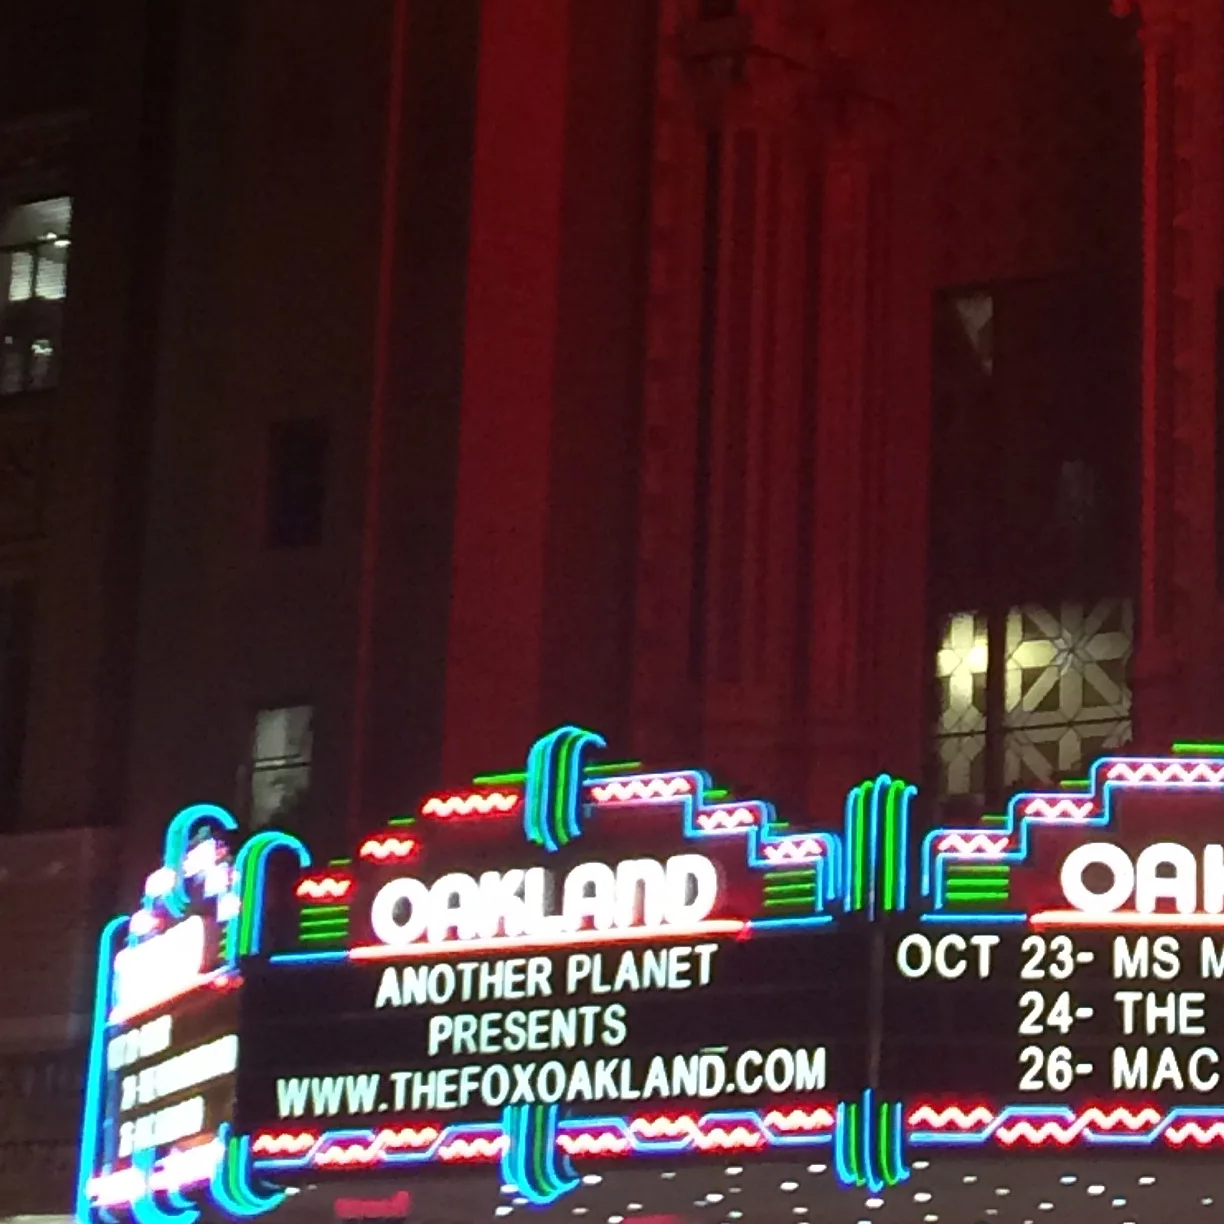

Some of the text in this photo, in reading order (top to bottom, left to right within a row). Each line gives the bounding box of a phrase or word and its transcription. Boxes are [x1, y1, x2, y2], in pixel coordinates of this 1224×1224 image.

[372, 854, 717, 945] OAKLAND
[376, 942, 717, 1008] ANOTHER PLANET
[897, 934, 999, 979] OCT
[1021, 936, 1093, 979] 23-
[1114, 936, 1180, 979] MS
[428, 1004, 627, 1056] PRESENTS
[1019, 993, 1093, 1035] 24-
[1115, 993, 1206, 1036] THE
[276, 1047, 827, 1118] WWW.THEFOXOAKLAND.COM
[1019, 1047, 1093, 1091] 26-
[1113, 1047, 1220, 1091] MAC
